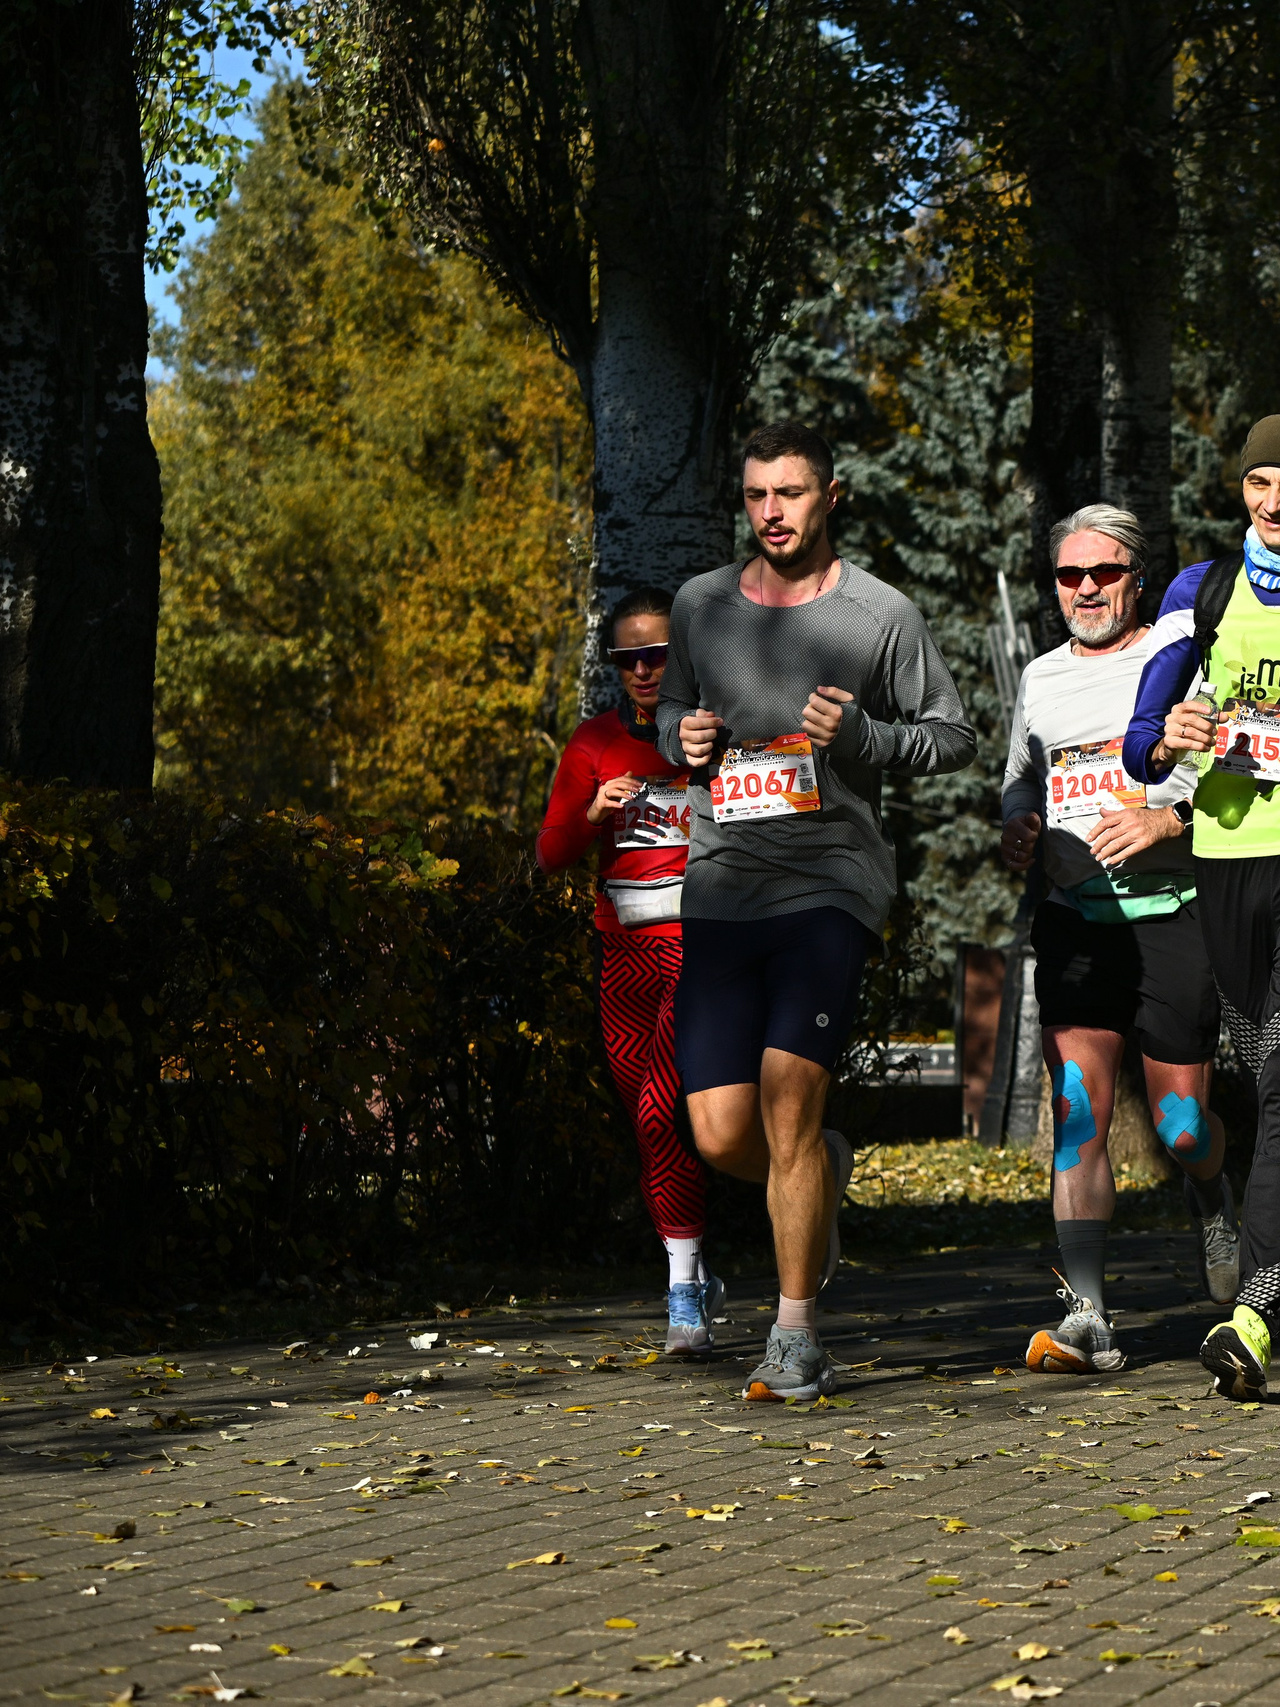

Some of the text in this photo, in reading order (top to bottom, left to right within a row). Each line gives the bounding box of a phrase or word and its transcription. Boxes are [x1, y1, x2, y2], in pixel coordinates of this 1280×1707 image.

[726, 768, 798, 800] 2067
[1066, 769, 1127, 799] 2041
[627, 804, 690, 829] 2046
